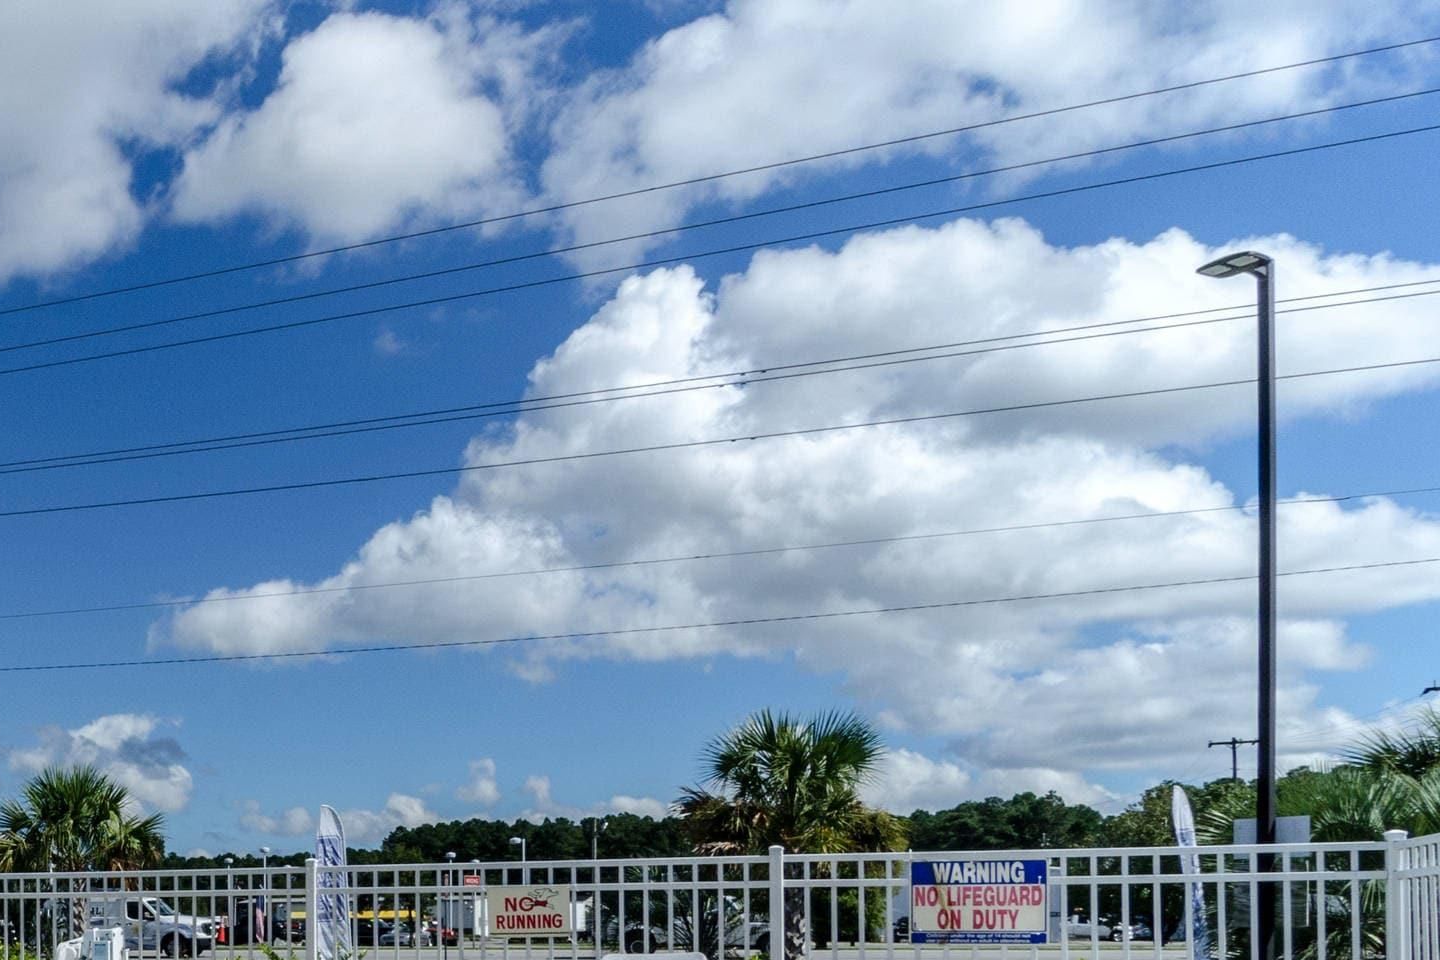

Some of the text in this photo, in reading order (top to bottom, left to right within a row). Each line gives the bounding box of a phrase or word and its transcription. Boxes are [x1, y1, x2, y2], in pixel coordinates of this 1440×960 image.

[932, 861, 1025, 884] WARNING
[504, 896, 535, 912] NO
[914, 886, 1043, 907] NO LIFEGUARD
[496, 913, 563, 929] RUNNING
[937, 909, 1019, 929] ON DUTY
